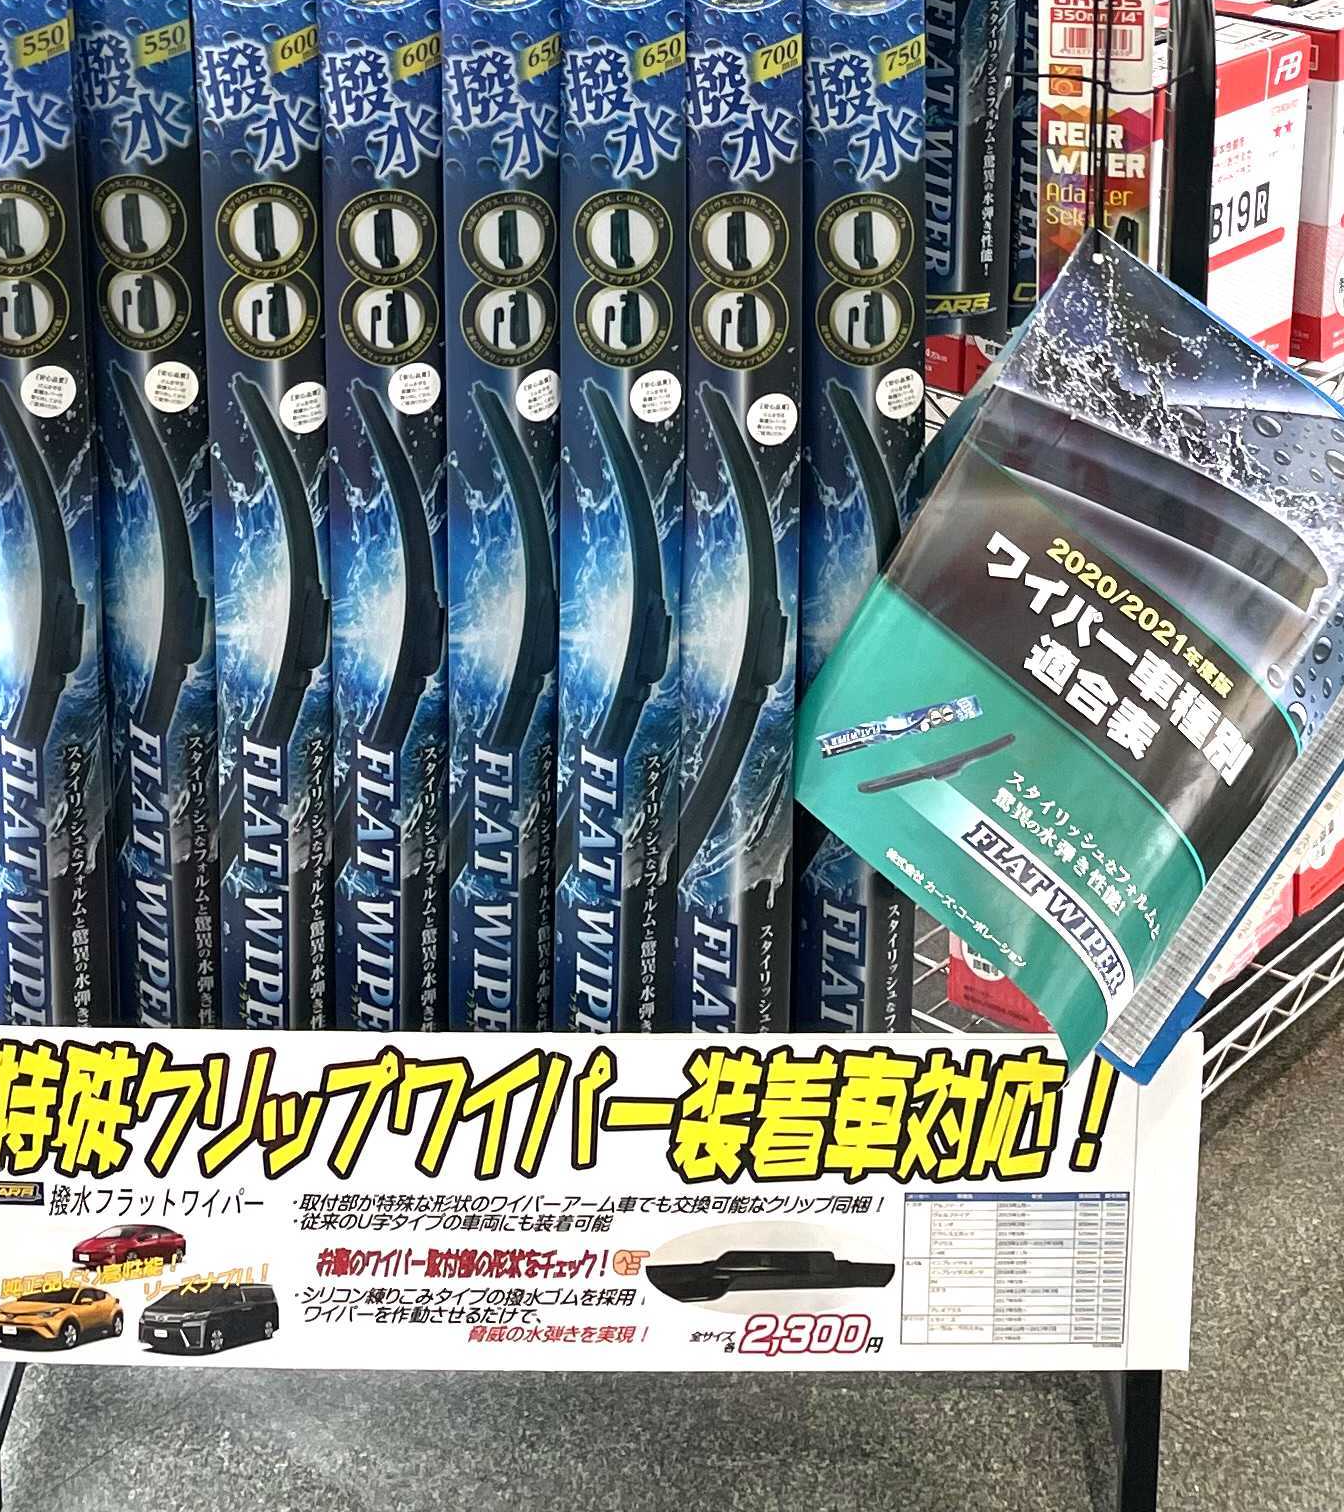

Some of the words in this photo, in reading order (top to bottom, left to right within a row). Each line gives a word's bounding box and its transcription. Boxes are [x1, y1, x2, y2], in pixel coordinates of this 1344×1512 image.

[80, 34, 189, 165] 撥水
[201, 45, 319, 171] 撥水
[328, 51, 440, 179] 撥水
[451, 50, 558, 179] 撥水
[567, 50, 680, 178] 撥水
[686, 52, 800, 180] 撥水
[808, 56, 922, 181] 撥水
[984, 529, 1256, 788] ワイパー車種別
[1045, 536, 1235, 698] 2020/2021年度版
[1024, 631, 1164, 762] 適合表
[0, 735, 43, 884] FLAT
[129, 722, 165, 878] FLAT
[243, 736, 290, 888] FLAT
[357, 739, 395, 892] FLAT
[473, 744, 514, 898] FLAT
[578, 744, 619, 904] FLAT
[136, 878, 173, 1029] WIPE
[961, 820, 1056, 896] FLAT
[1045, 885, 1127, 999] WIPER
[49, 1184, 264, 1218] 撥水フラットワイパー
[739, 1314, 871, 1357] 2,300
[866, 1337, 883, 1354] 円
